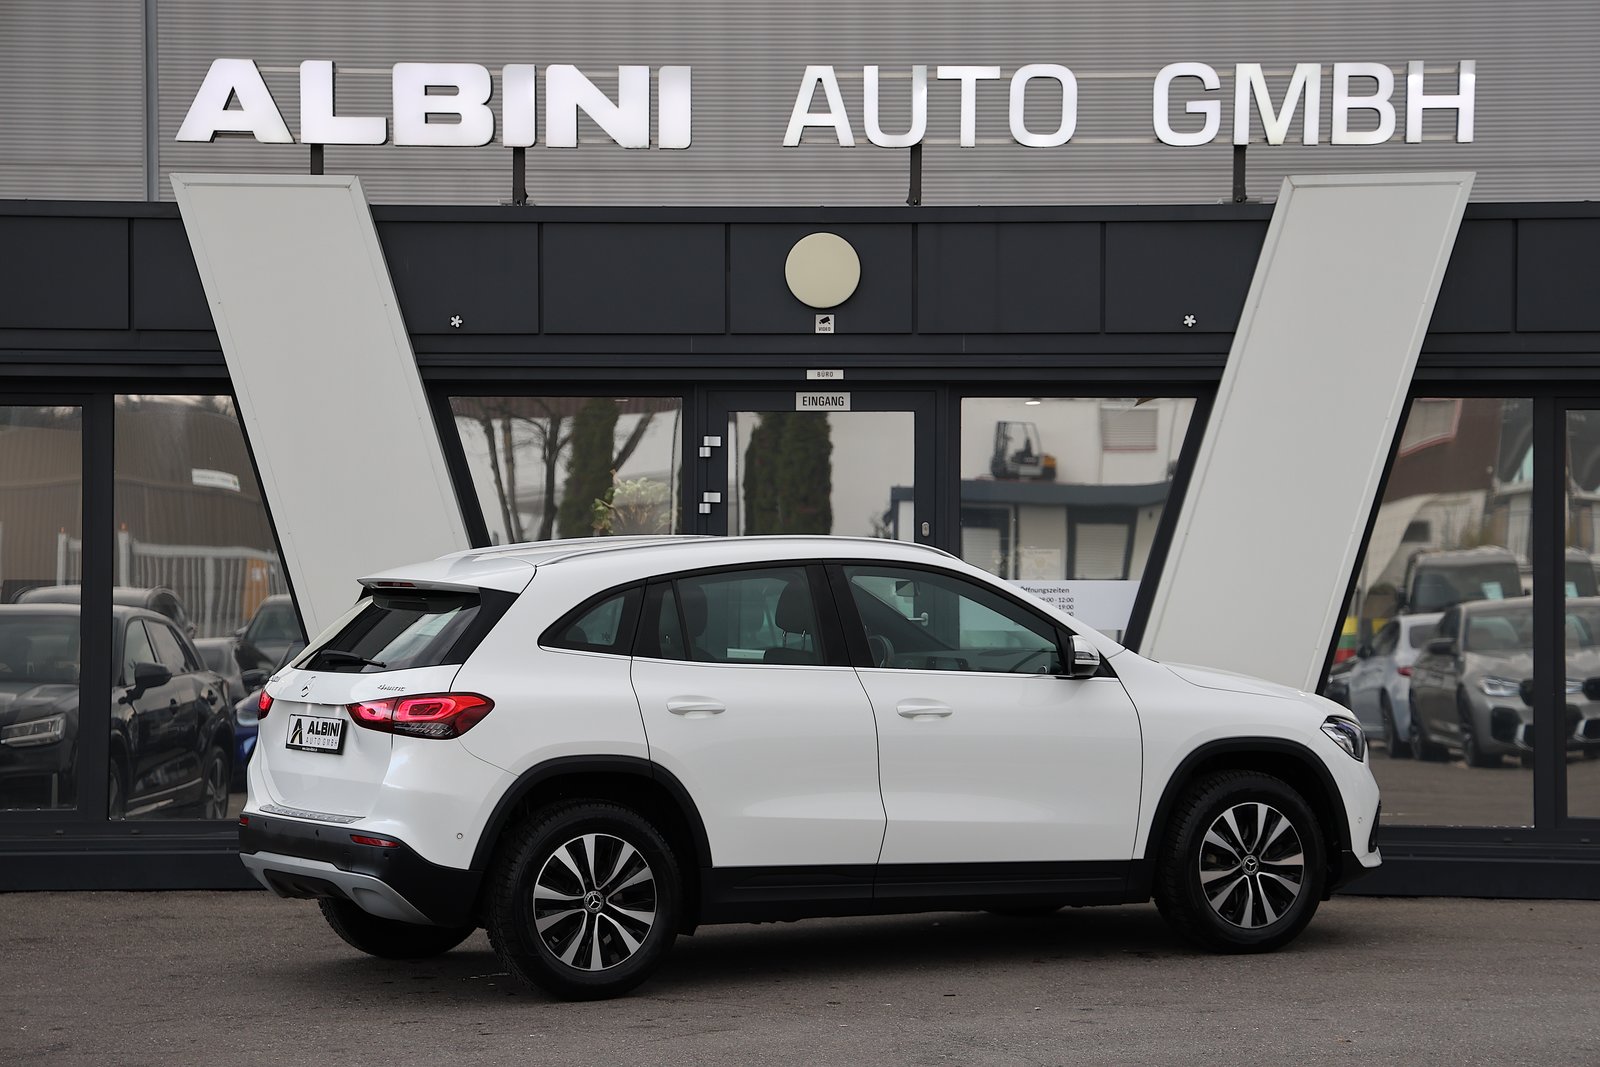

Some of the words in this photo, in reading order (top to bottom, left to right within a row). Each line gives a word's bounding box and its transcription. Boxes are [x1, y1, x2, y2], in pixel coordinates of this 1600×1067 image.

[175, 58, 692, 149] ALBINI
[782, 64, 1078, 148] AUTO
[1152, 60, 1476, 147] GMBH
[802, 396, 845, 407] EINGANG
[307, 720, 340, 736] ALBINI
[305, 736, 321, 746] AUTO
